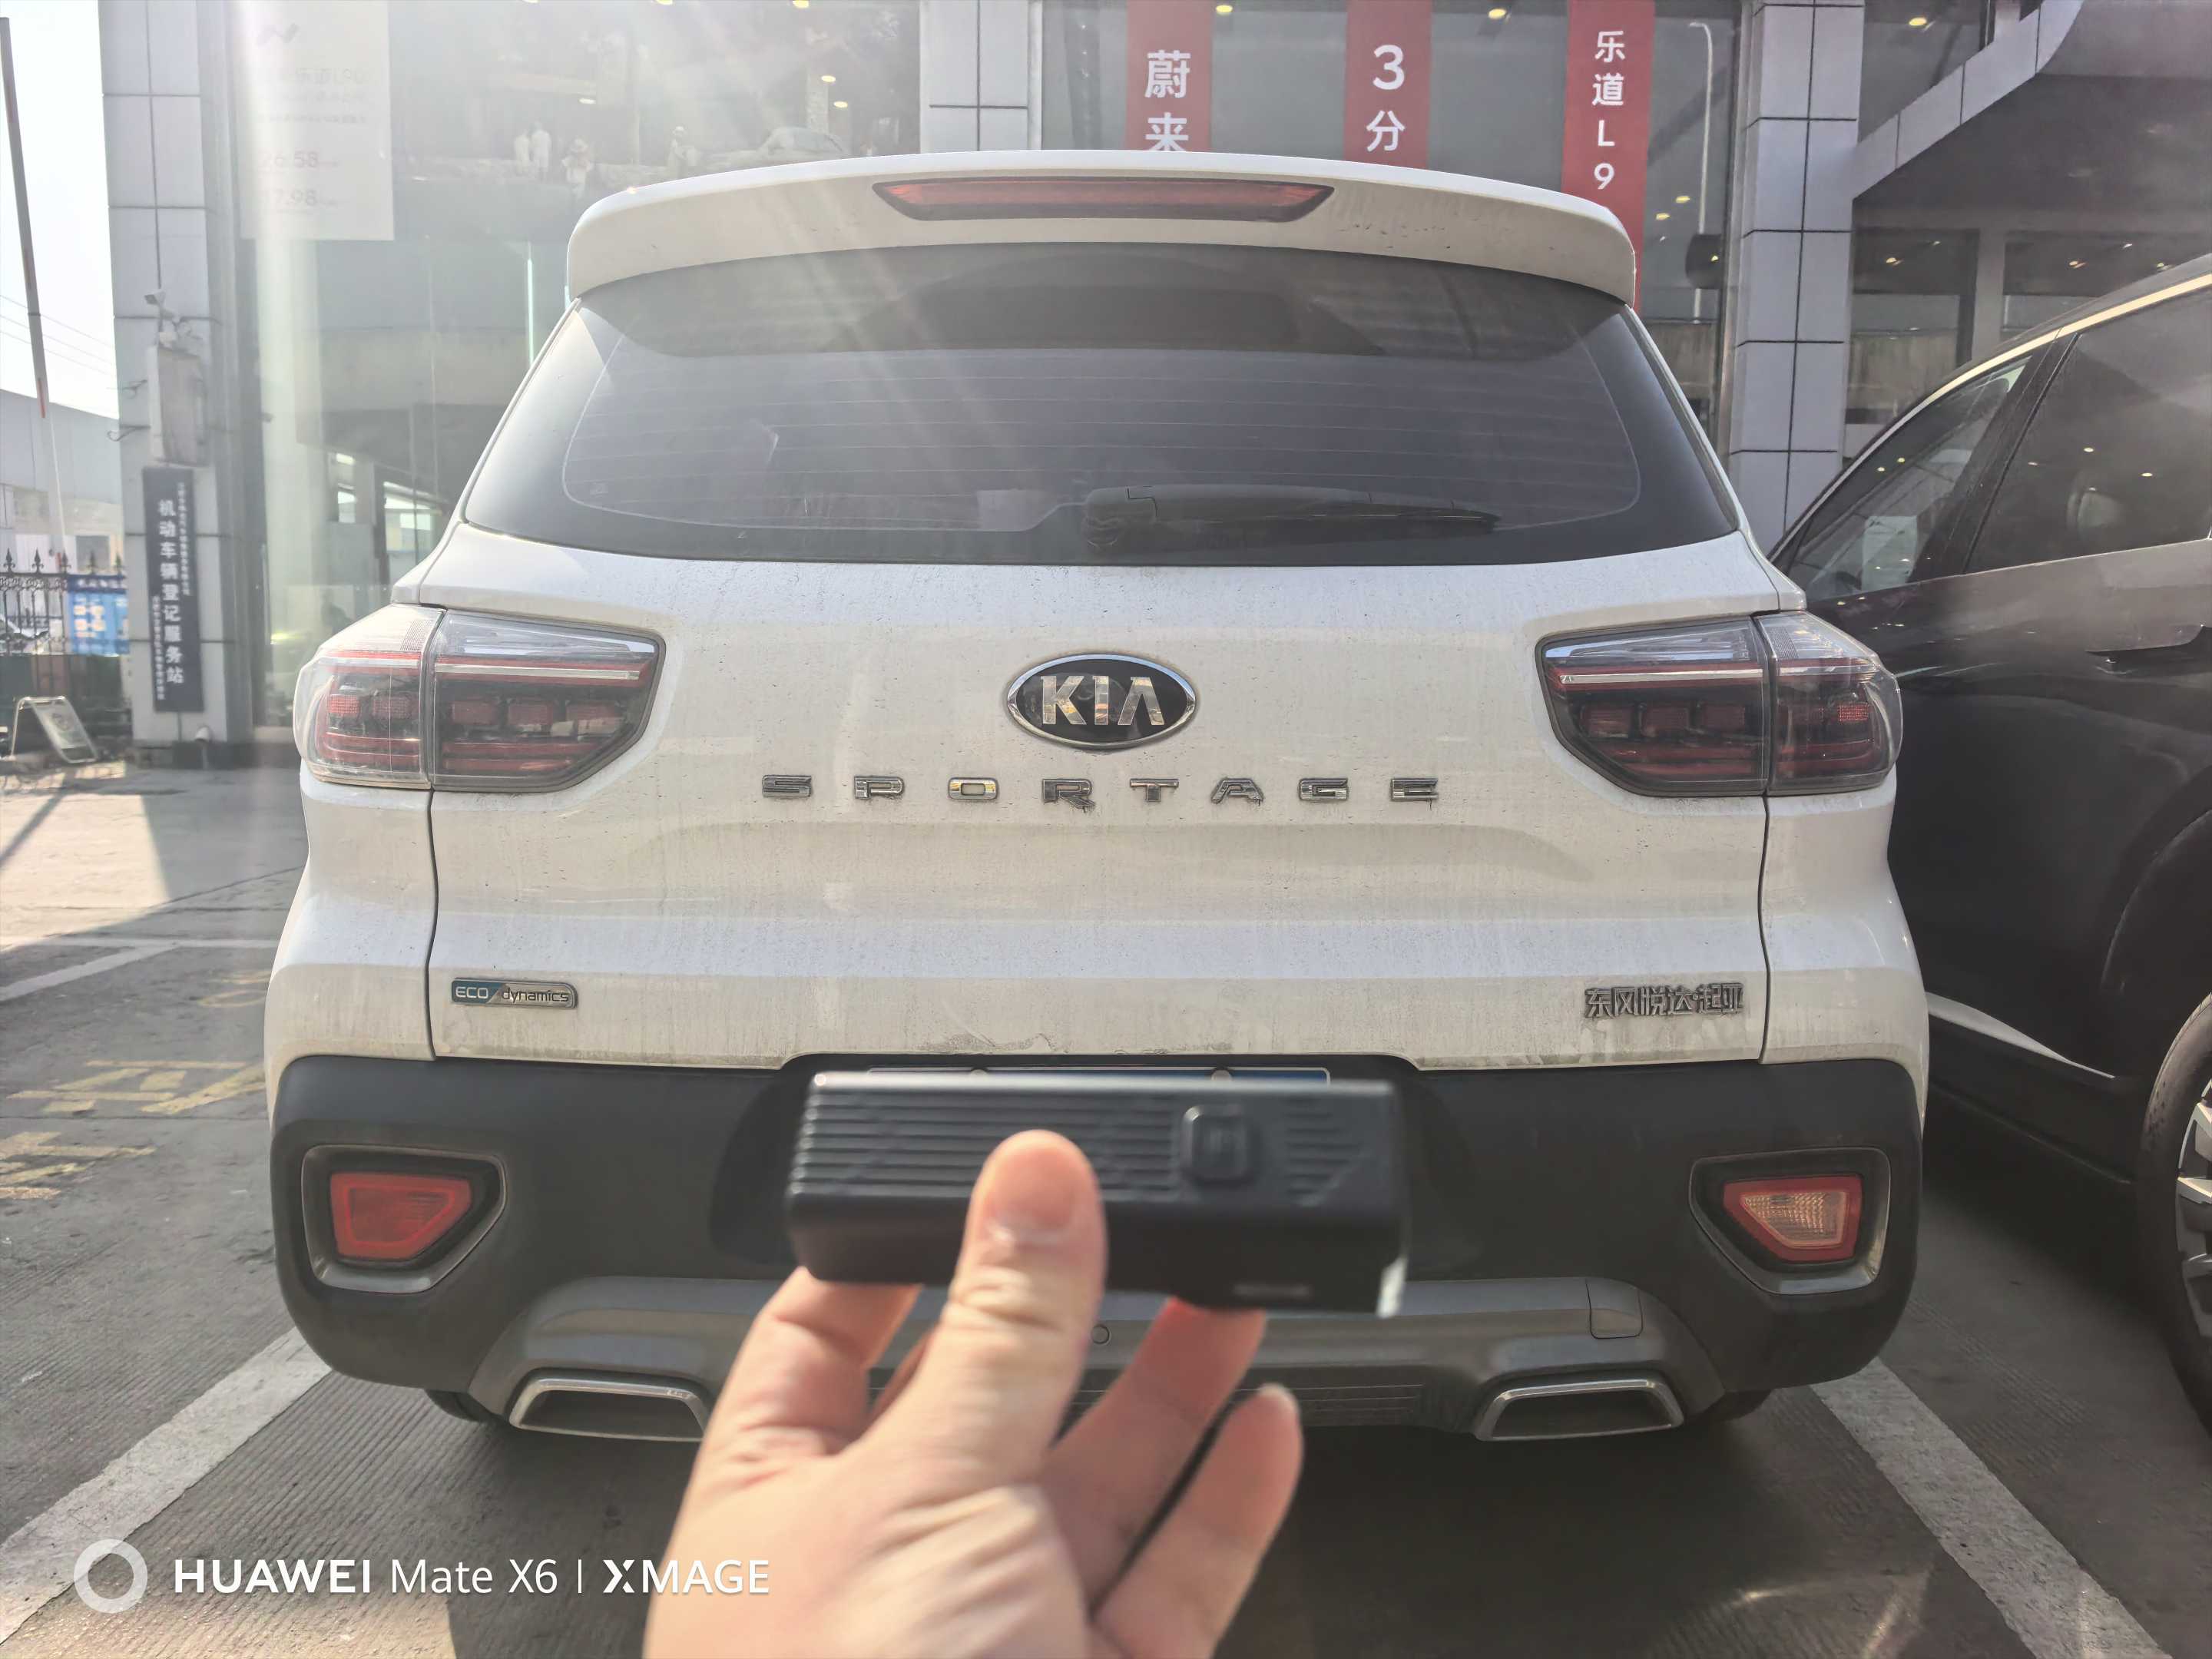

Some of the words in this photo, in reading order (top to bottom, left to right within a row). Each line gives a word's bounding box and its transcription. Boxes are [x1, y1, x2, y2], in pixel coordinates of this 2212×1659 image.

[1144, 49, 1191, 151] 蔚来
[1366, 44, 1406, 152] 3分
[1592, 30, 1626, 190] 乐道L9
[1040, 675, 1167, 726] KIA
[762, 773, 1439, 808] SPORTAGE
[455, 987, 488, 999] ECO
[501, 988, 570, 1004] dynamics
